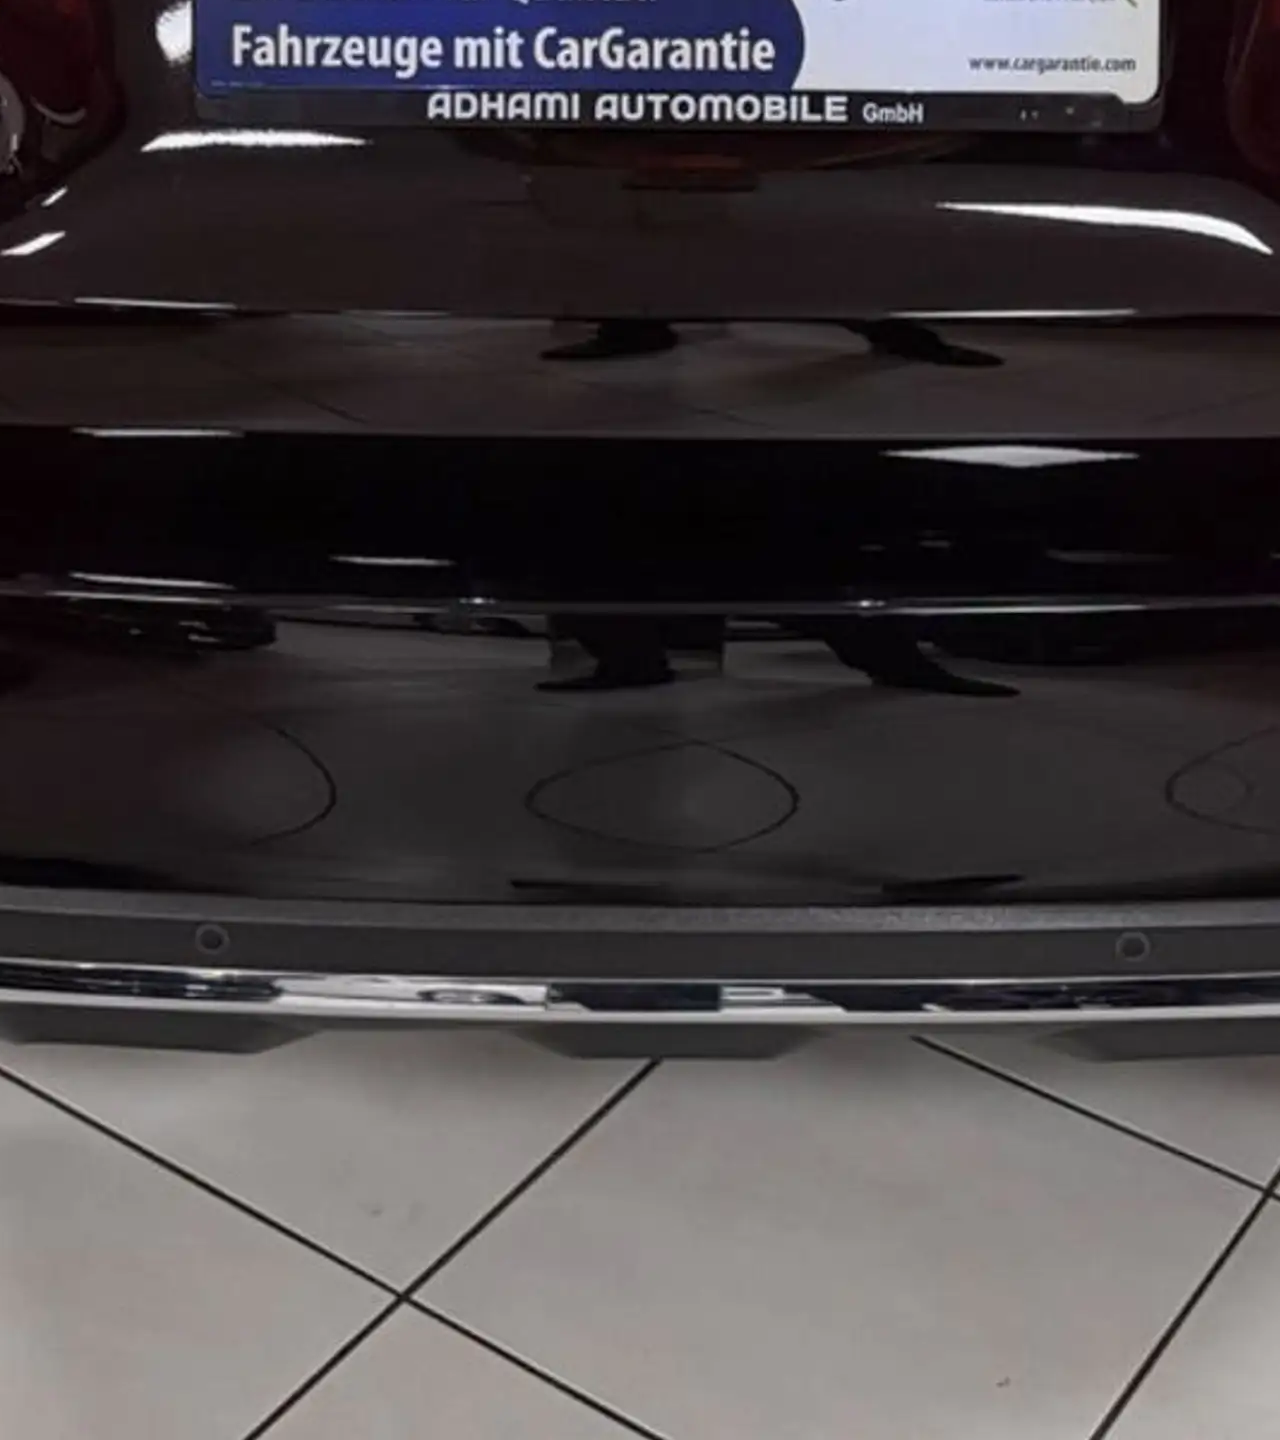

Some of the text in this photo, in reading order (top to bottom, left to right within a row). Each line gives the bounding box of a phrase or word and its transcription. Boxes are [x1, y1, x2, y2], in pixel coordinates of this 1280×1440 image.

[232, 23, 776, 79] Fahrzeuge mit CarGarantie
[969, 55, 1137, 76] www.cargarantie.com
[426, 91, 924, 124] ADHAMI AUTOMOBILE GmbH
